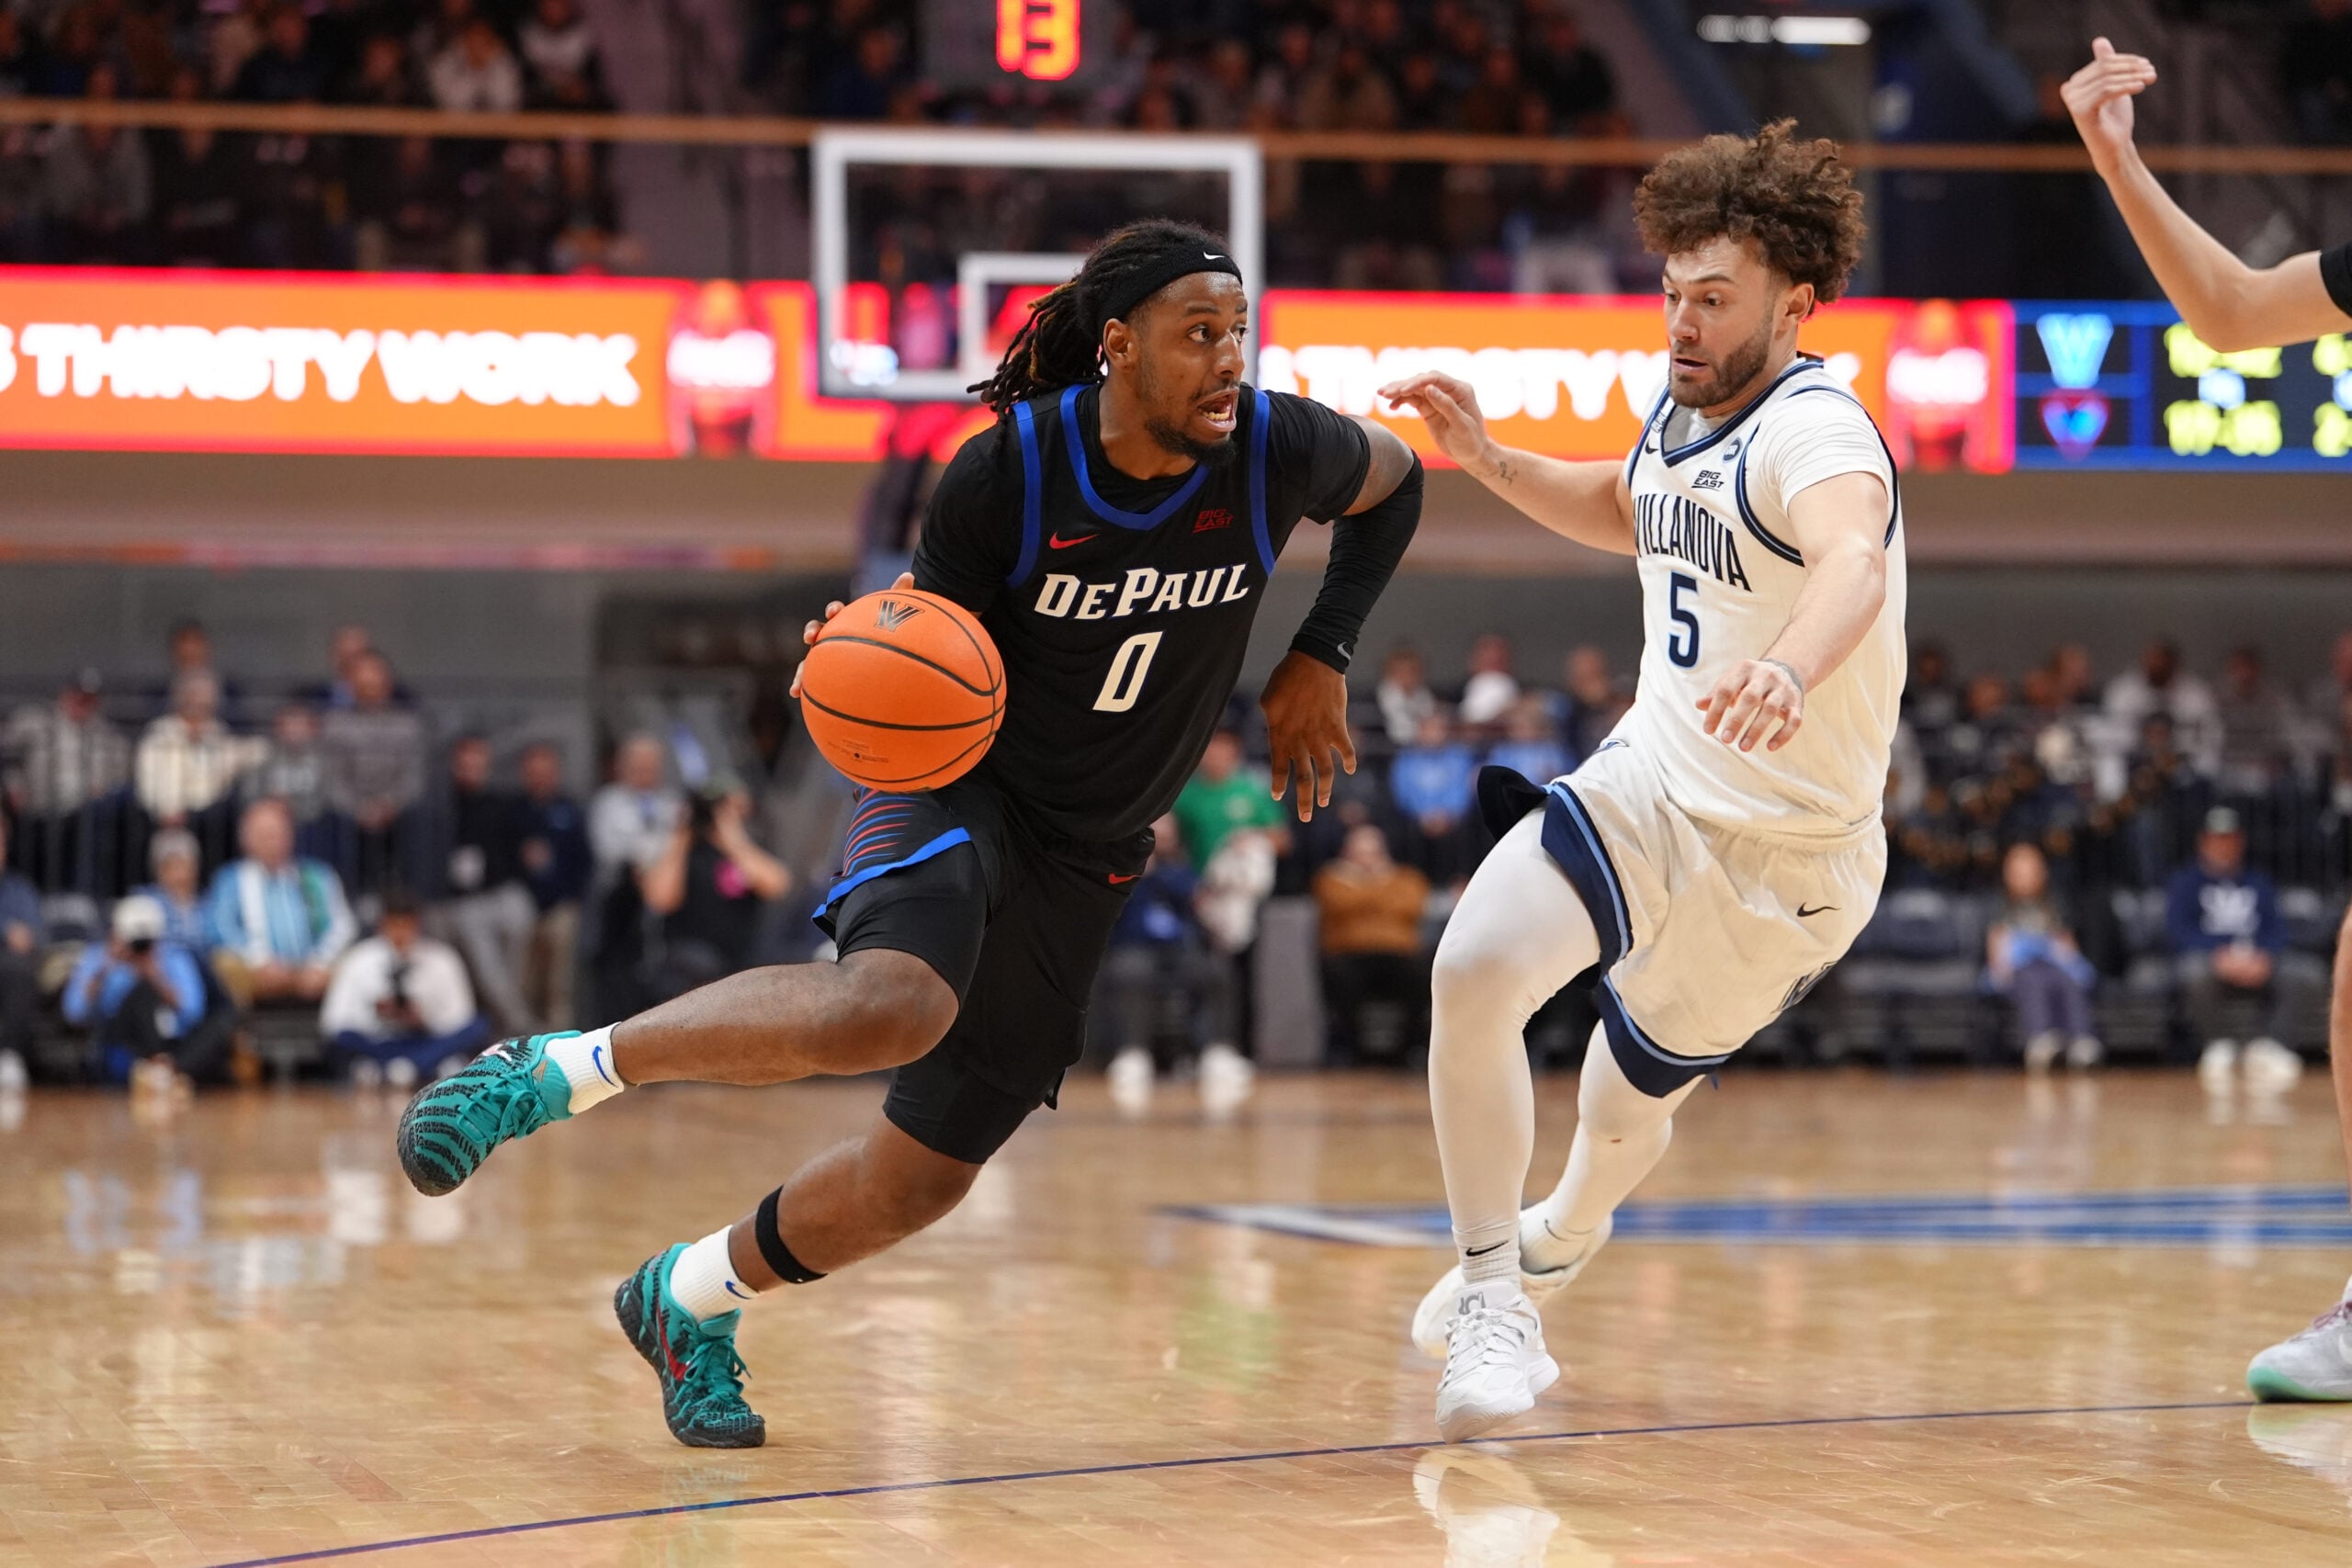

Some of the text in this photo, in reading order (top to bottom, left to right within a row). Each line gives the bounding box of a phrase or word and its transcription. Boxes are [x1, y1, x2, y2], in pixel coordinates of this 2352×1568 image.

[378, 330, 640, 406] WORK
[1693, 478, 1725, 489] EAST
[1699, 469, 1722, 480] BIG
[1634, 493, 1753, 592] VILLANOVA
[1668, 570, 1700, 669] 5
[1091, 631, 1164, 713] 0
